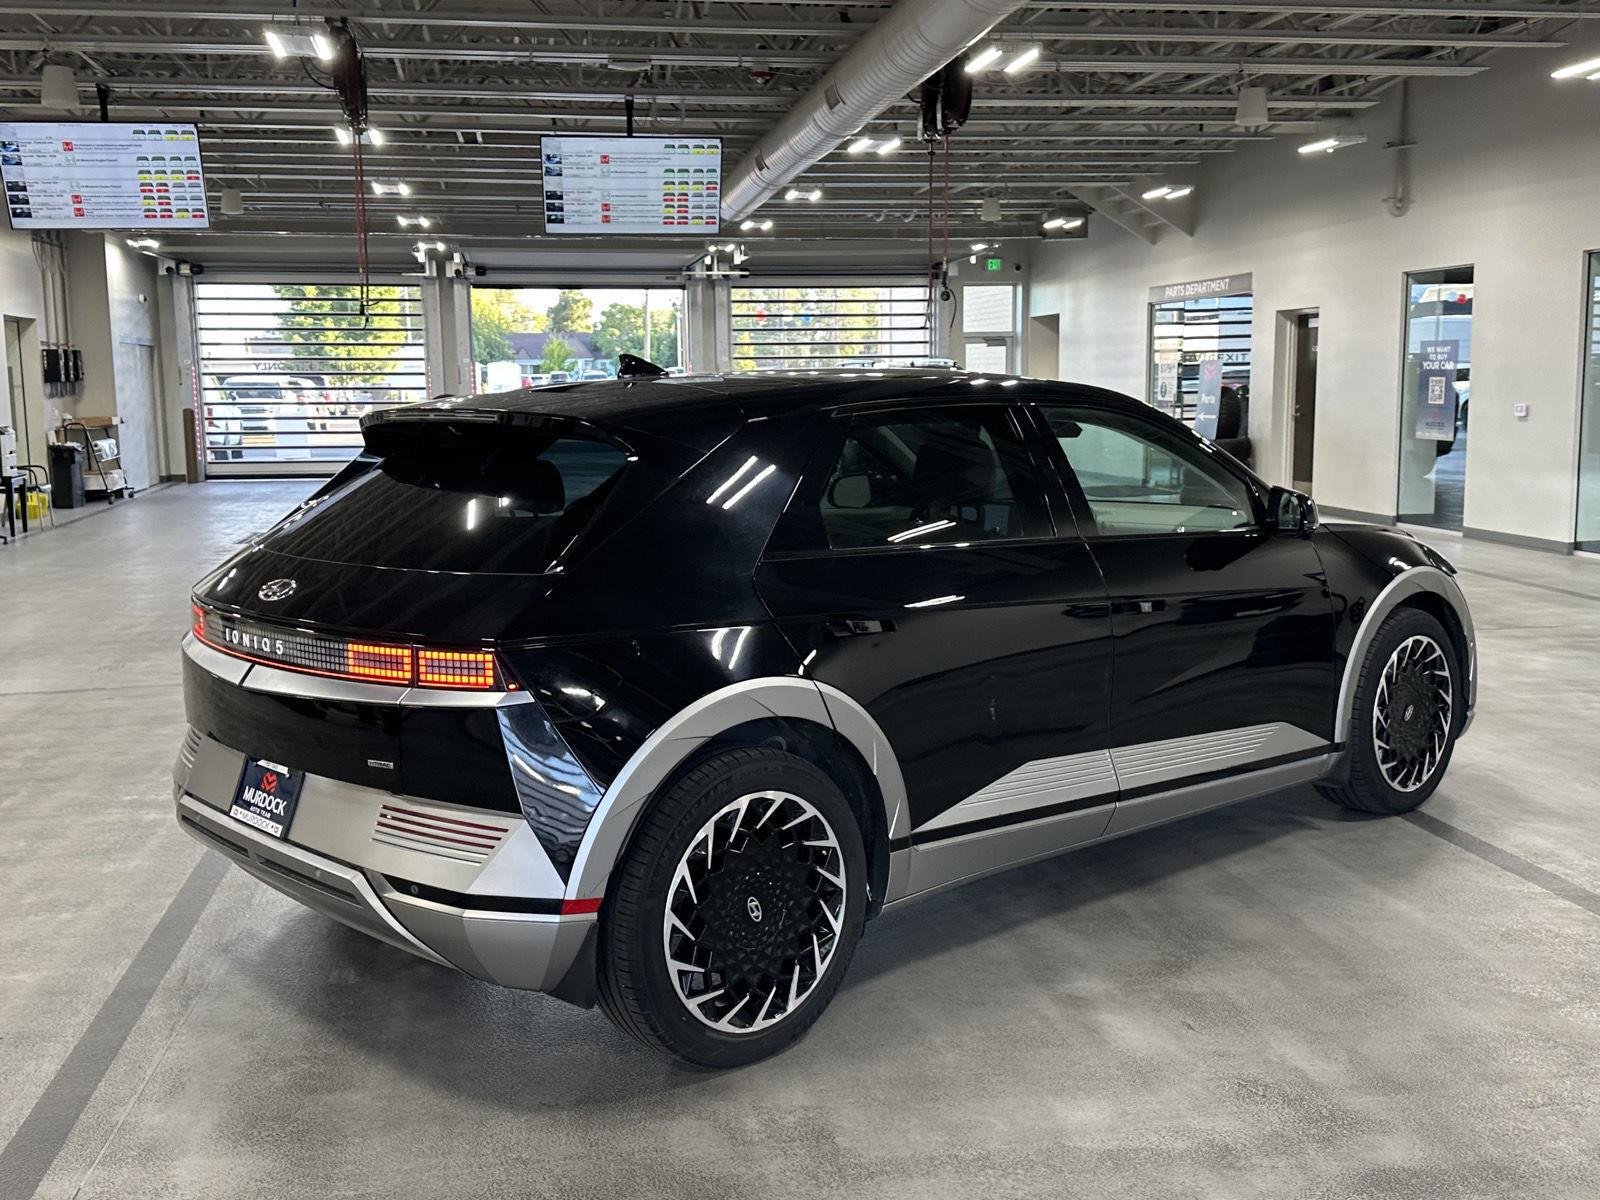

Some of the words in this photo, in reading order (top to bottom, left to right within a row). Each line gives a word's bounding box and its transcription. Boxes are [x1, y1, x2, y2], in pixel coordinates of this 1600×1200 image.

[988, 259, 1001, 270] EXIT
[1165, 285, 1185, 298] PARTS
[1186, 278, 1230, 296] DEPARTMENT
[1422, 361, 1440, 370] YOUR
[1440, 361, 1455, 370] CAR
[225, 628, 270, 653] IONIQ
[275, 640, 284, 655] 5
[242, 786, 288, 816] MURDOCK
[250, 805, 261, 815] AUTO
[260, 809, 272, 819] TEAM
